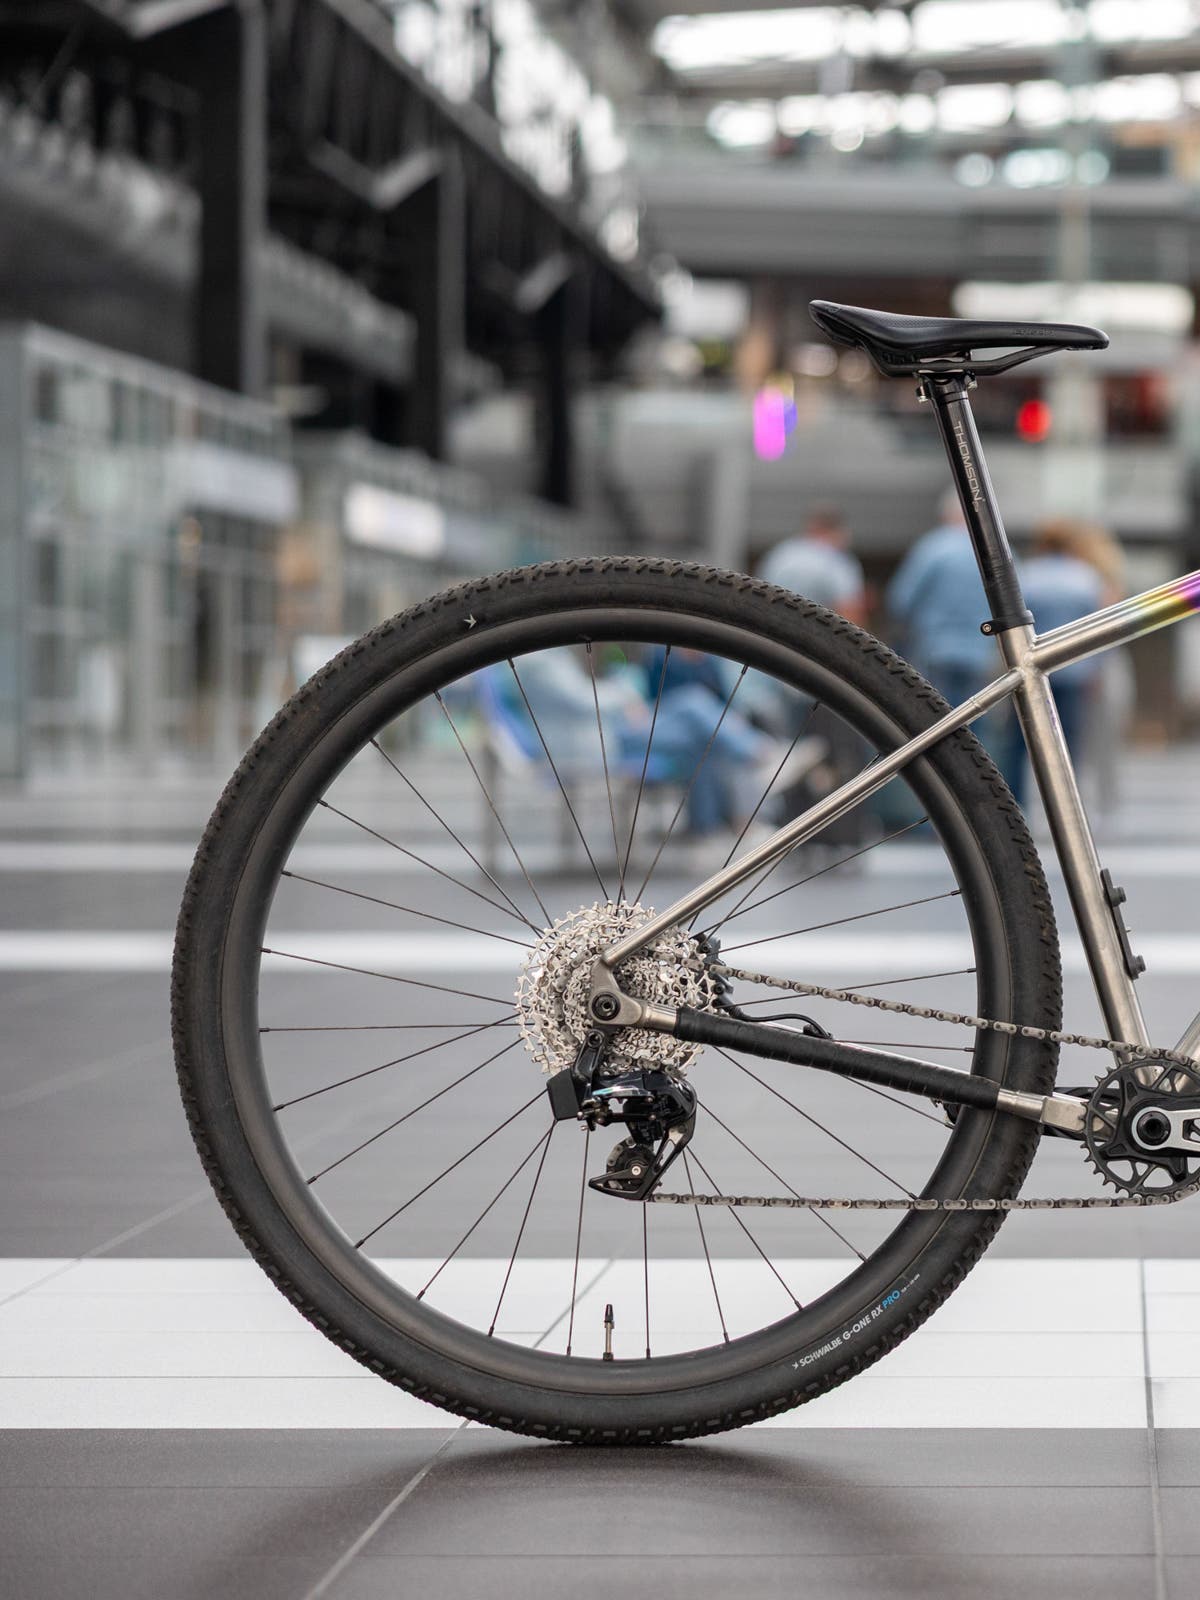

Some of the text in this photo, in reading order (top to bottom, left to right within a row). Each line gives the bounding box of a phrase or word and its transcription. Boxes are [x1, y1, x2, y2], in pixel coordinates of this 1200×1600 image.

[953, 420, 983, 502] THOMSON
[799, 1290, 901, 1367] SCHWALBE G-ONE RX PRO
